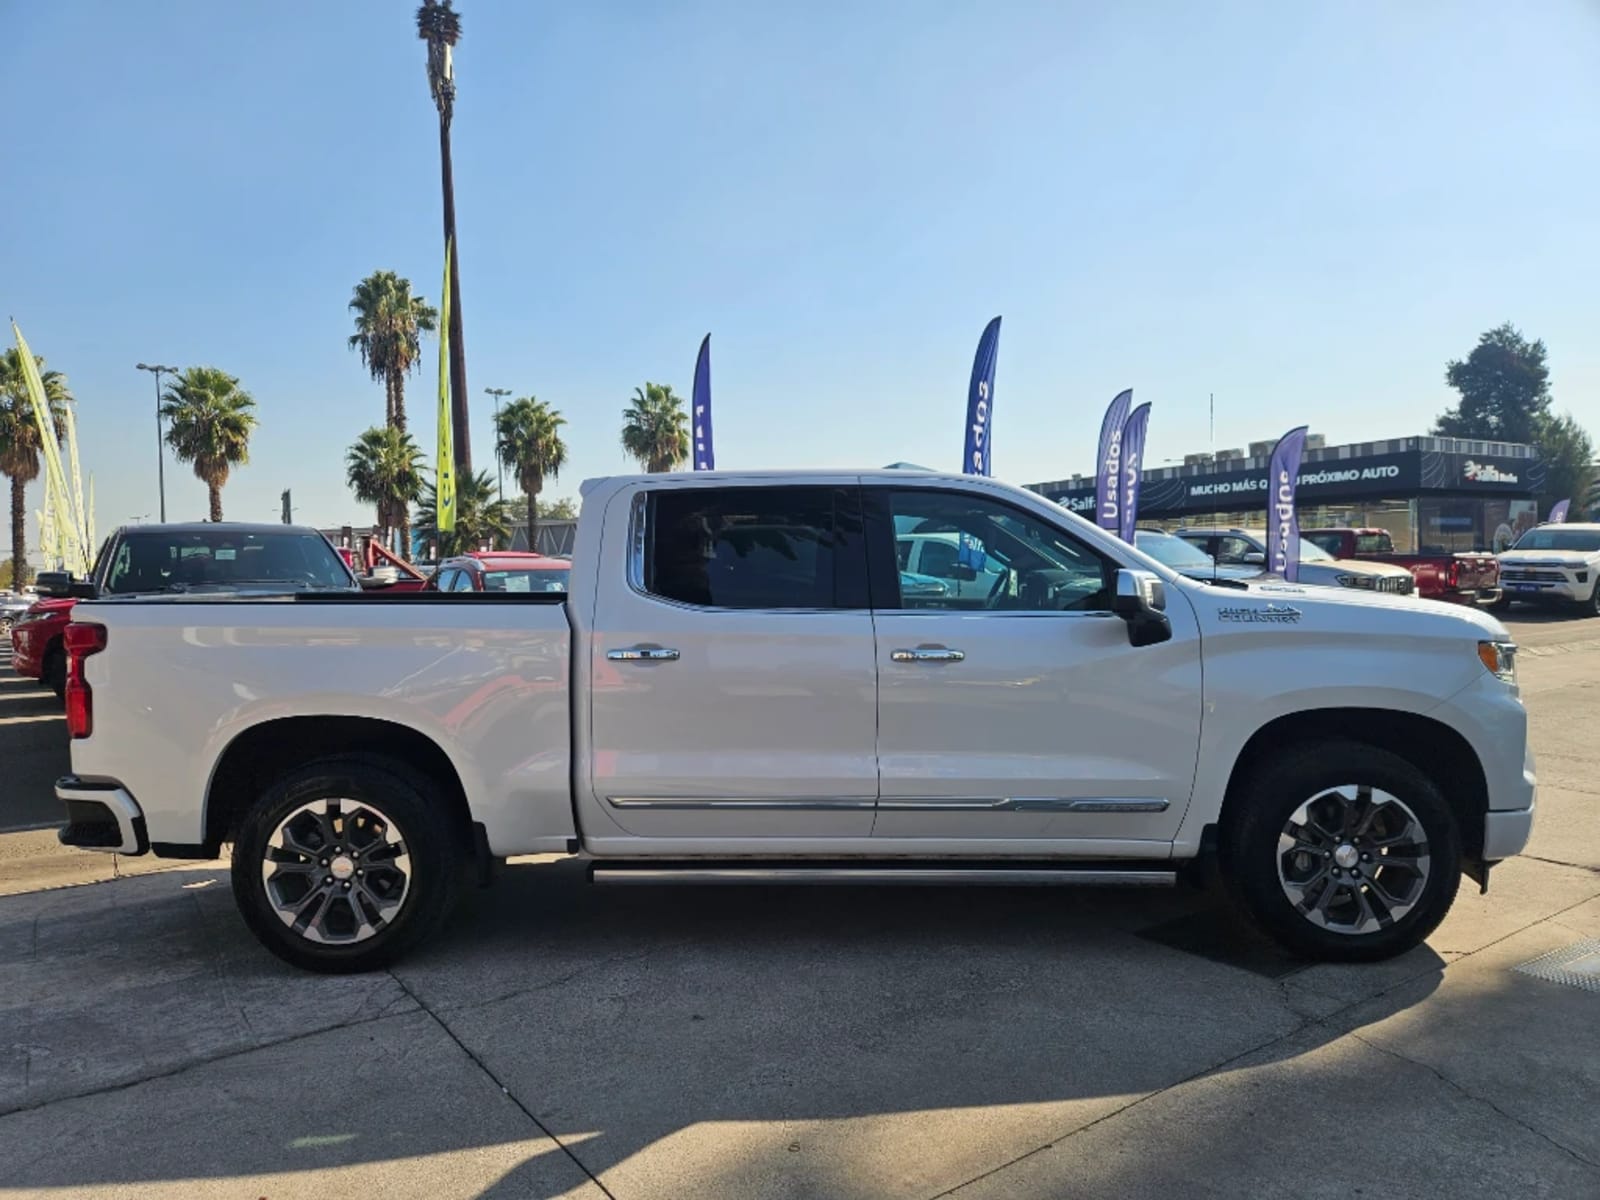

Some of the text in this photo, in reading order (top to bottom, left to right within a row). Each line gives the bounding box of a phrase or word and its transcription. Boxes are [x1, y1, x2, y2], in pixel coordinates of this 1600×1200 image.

[972, 381, 988, 477] ados
[1070, 496, 1096, 511] Salf
[1102, 430, 1121, 518] Usados
[1190, 482, 1230, 497] MUCHO
[1232, 478, 1257, 492] MÁS
[1302, 469, 1359, 486] PRÓXIMO
[1362, 465, 1399, 480] AUTO
